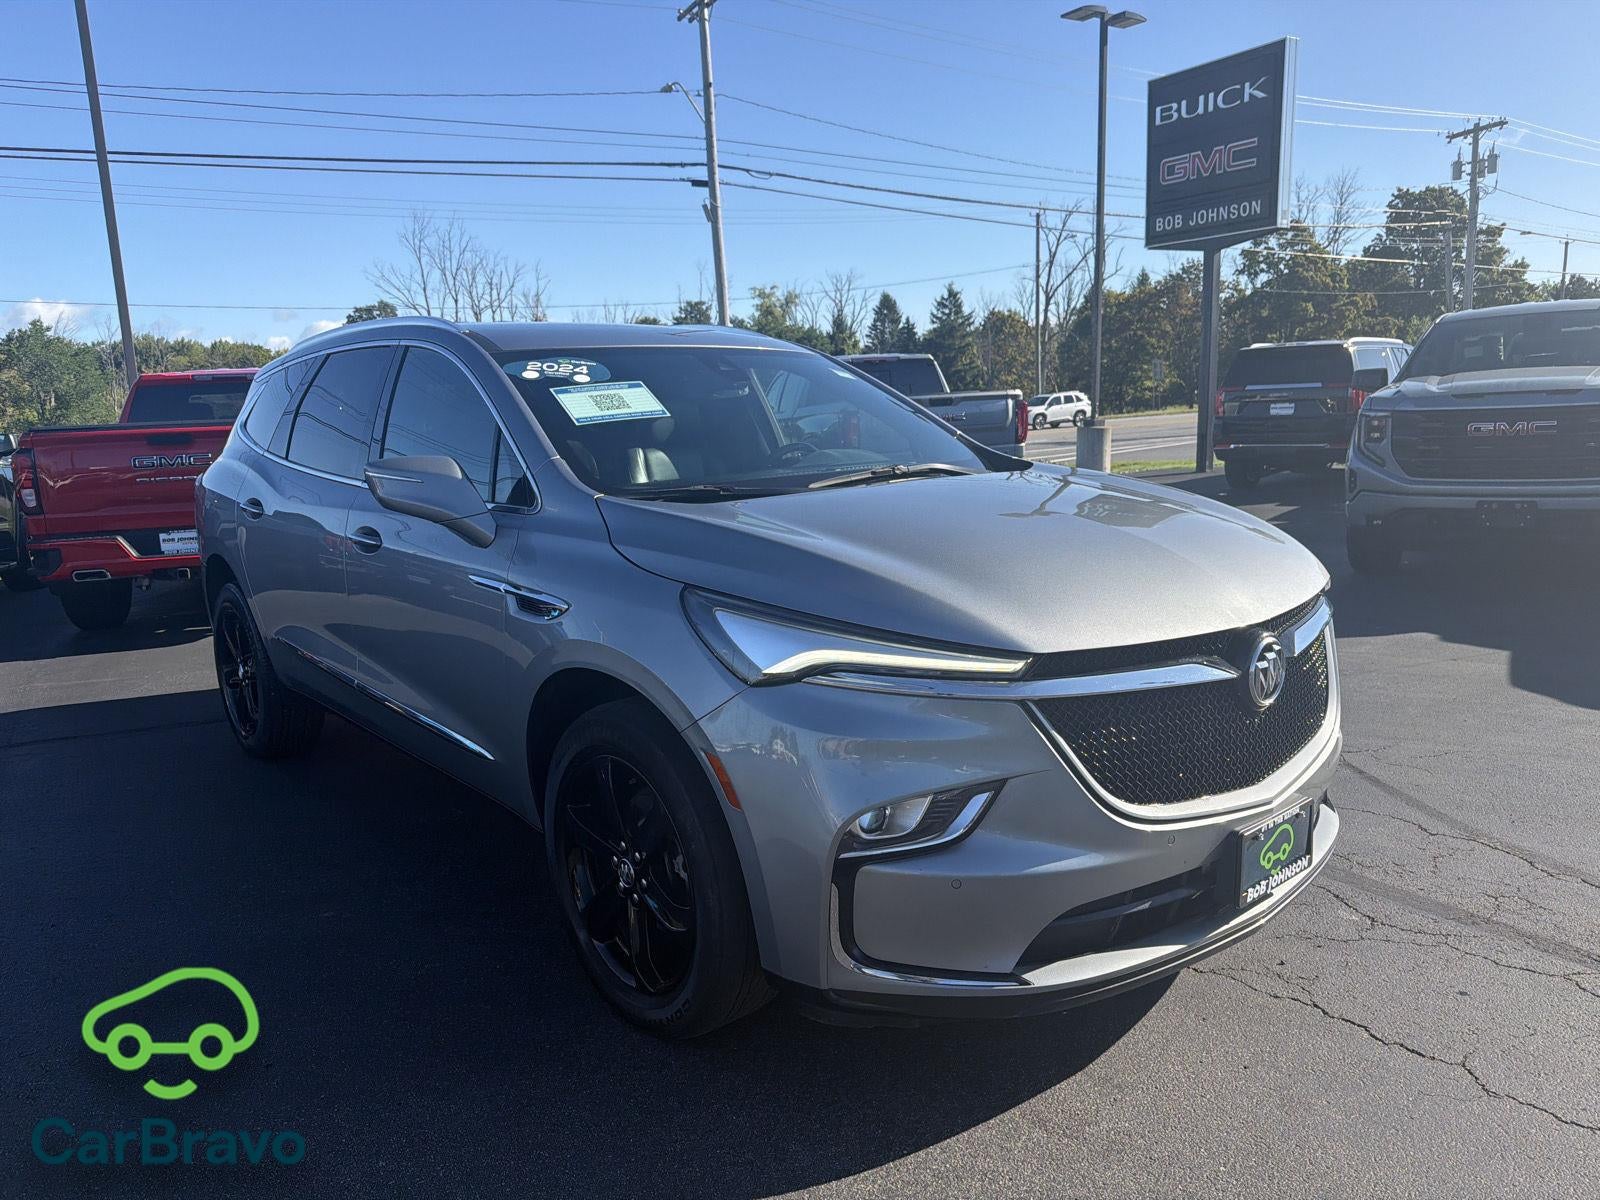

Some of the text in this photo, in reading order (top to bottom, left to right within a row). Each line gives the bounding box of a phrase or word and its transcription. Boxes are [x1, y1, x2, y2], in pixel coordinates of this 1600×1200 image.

[1155, 76, 1270, 126] BUICK
[1159, 137, 1258, 185] GMC
[1155, 200, 1261, 232] BOB JOHNSON
[526, 361, 589, 374] 2024
[1467, 421, 1557, 437] GMC
[131, 453, 212, 470] GMC
[1246, 855, 1311, 903] BOB JOHNSON
